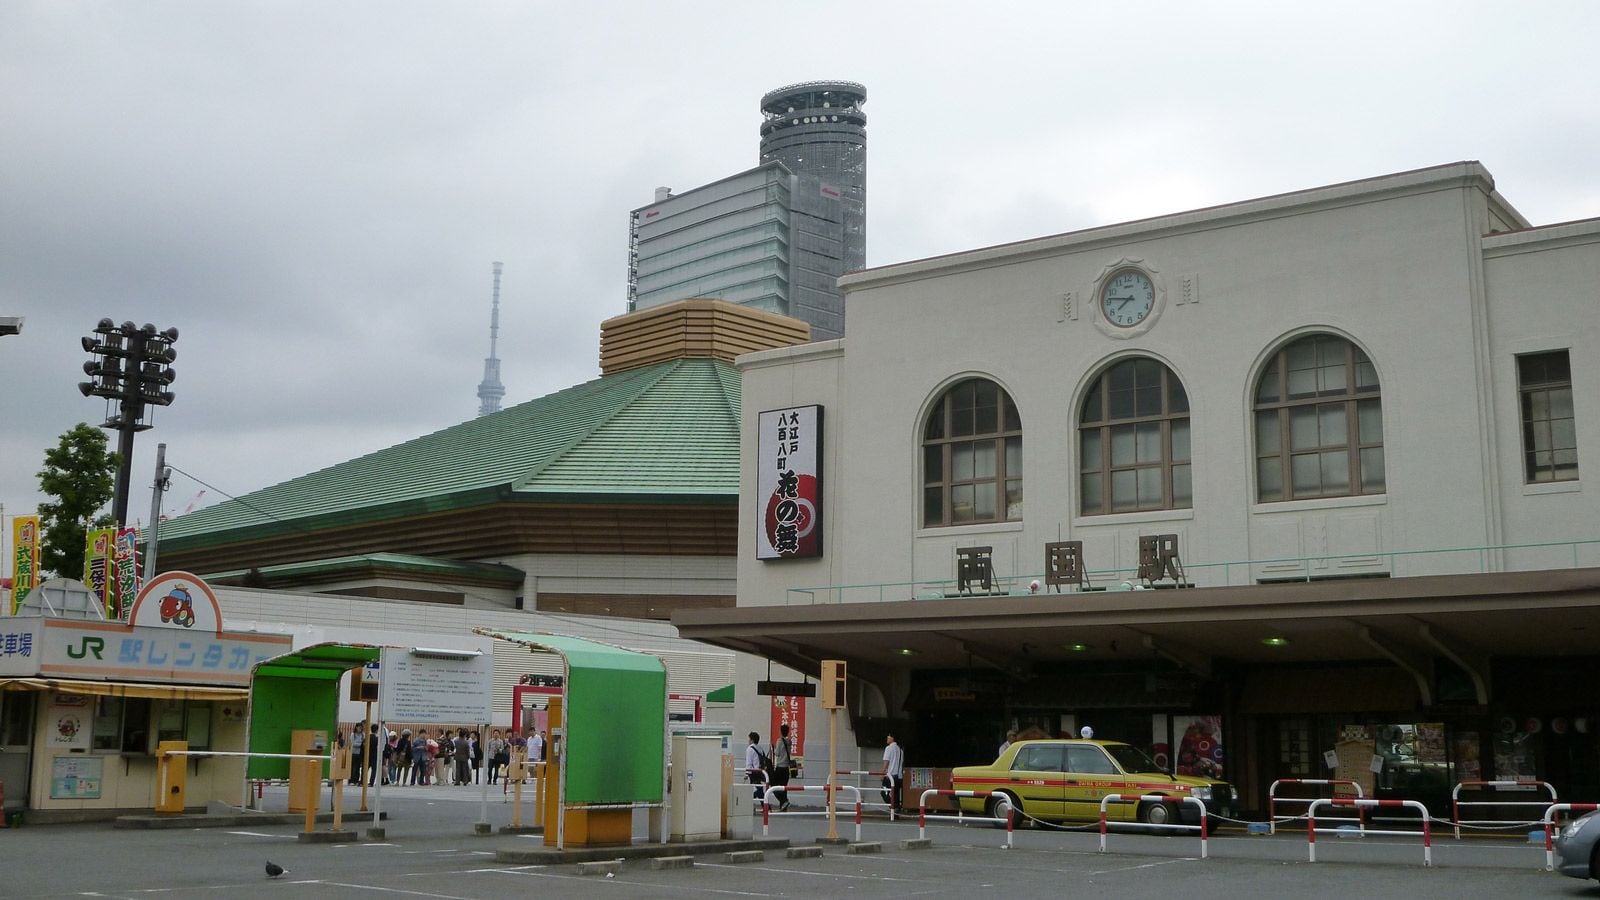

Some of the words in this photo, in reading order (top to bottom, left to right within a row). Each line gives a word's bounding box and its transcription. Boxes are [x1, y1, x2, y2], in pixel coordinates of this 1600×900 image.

[777, 413, 787, 470] 八百八町
[789, 411, 799, 455] 大江戸
[775, 470, 798, 553] 花の舞
[15, 546, 32, 611] 武蔵川部
[67, 636, 104, 660] JR
